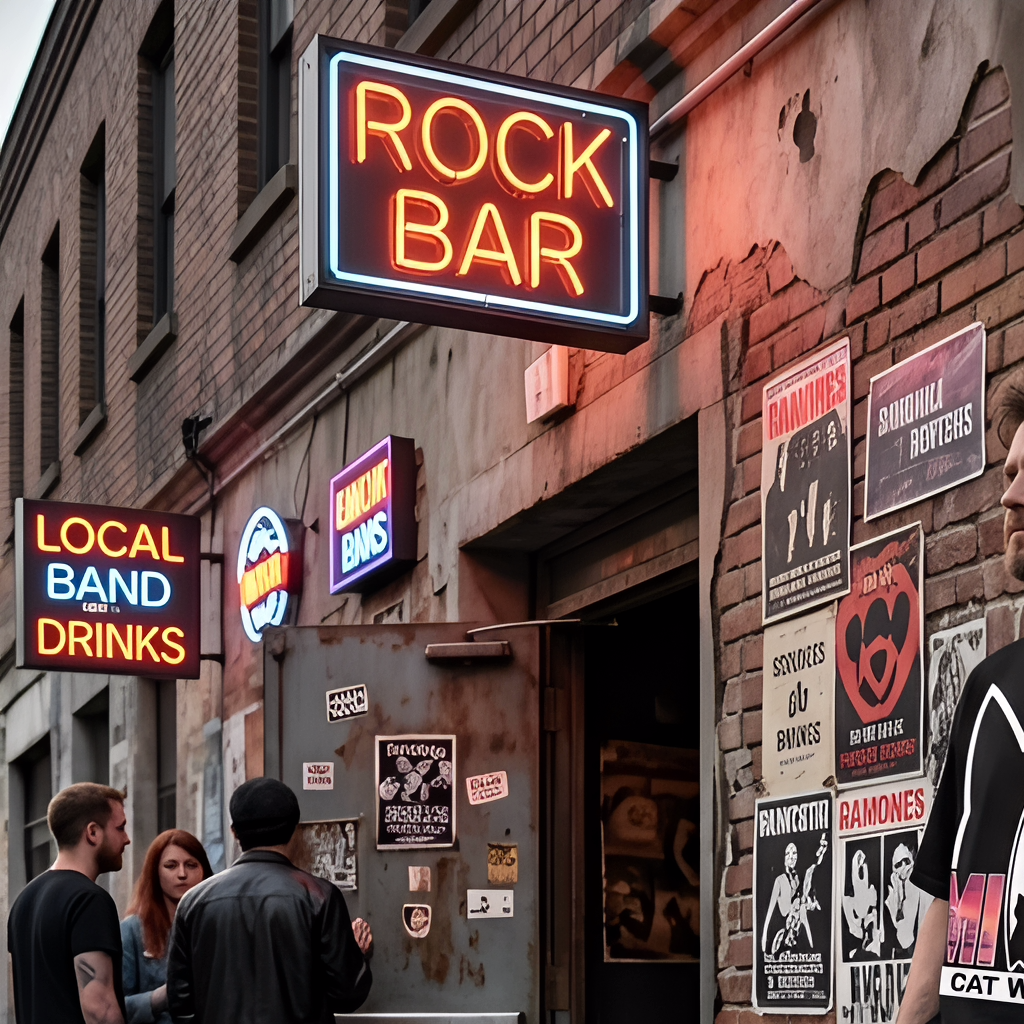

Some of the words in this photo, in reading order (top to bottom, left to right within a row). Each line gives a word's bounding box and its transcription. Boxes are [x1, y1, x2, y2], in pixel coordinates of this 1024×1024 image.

[352, 80, 614, 208] ROCK
[392, 187, 585, 297] BAR
[36, 514, 185, 563] LOCAL
[47, 562, 172, 608] BAND
[37, 617, 186, 665] DRINKS
[839, 787, 925, 831] RAMONES
[950, 972, 1000, 996] CAT
